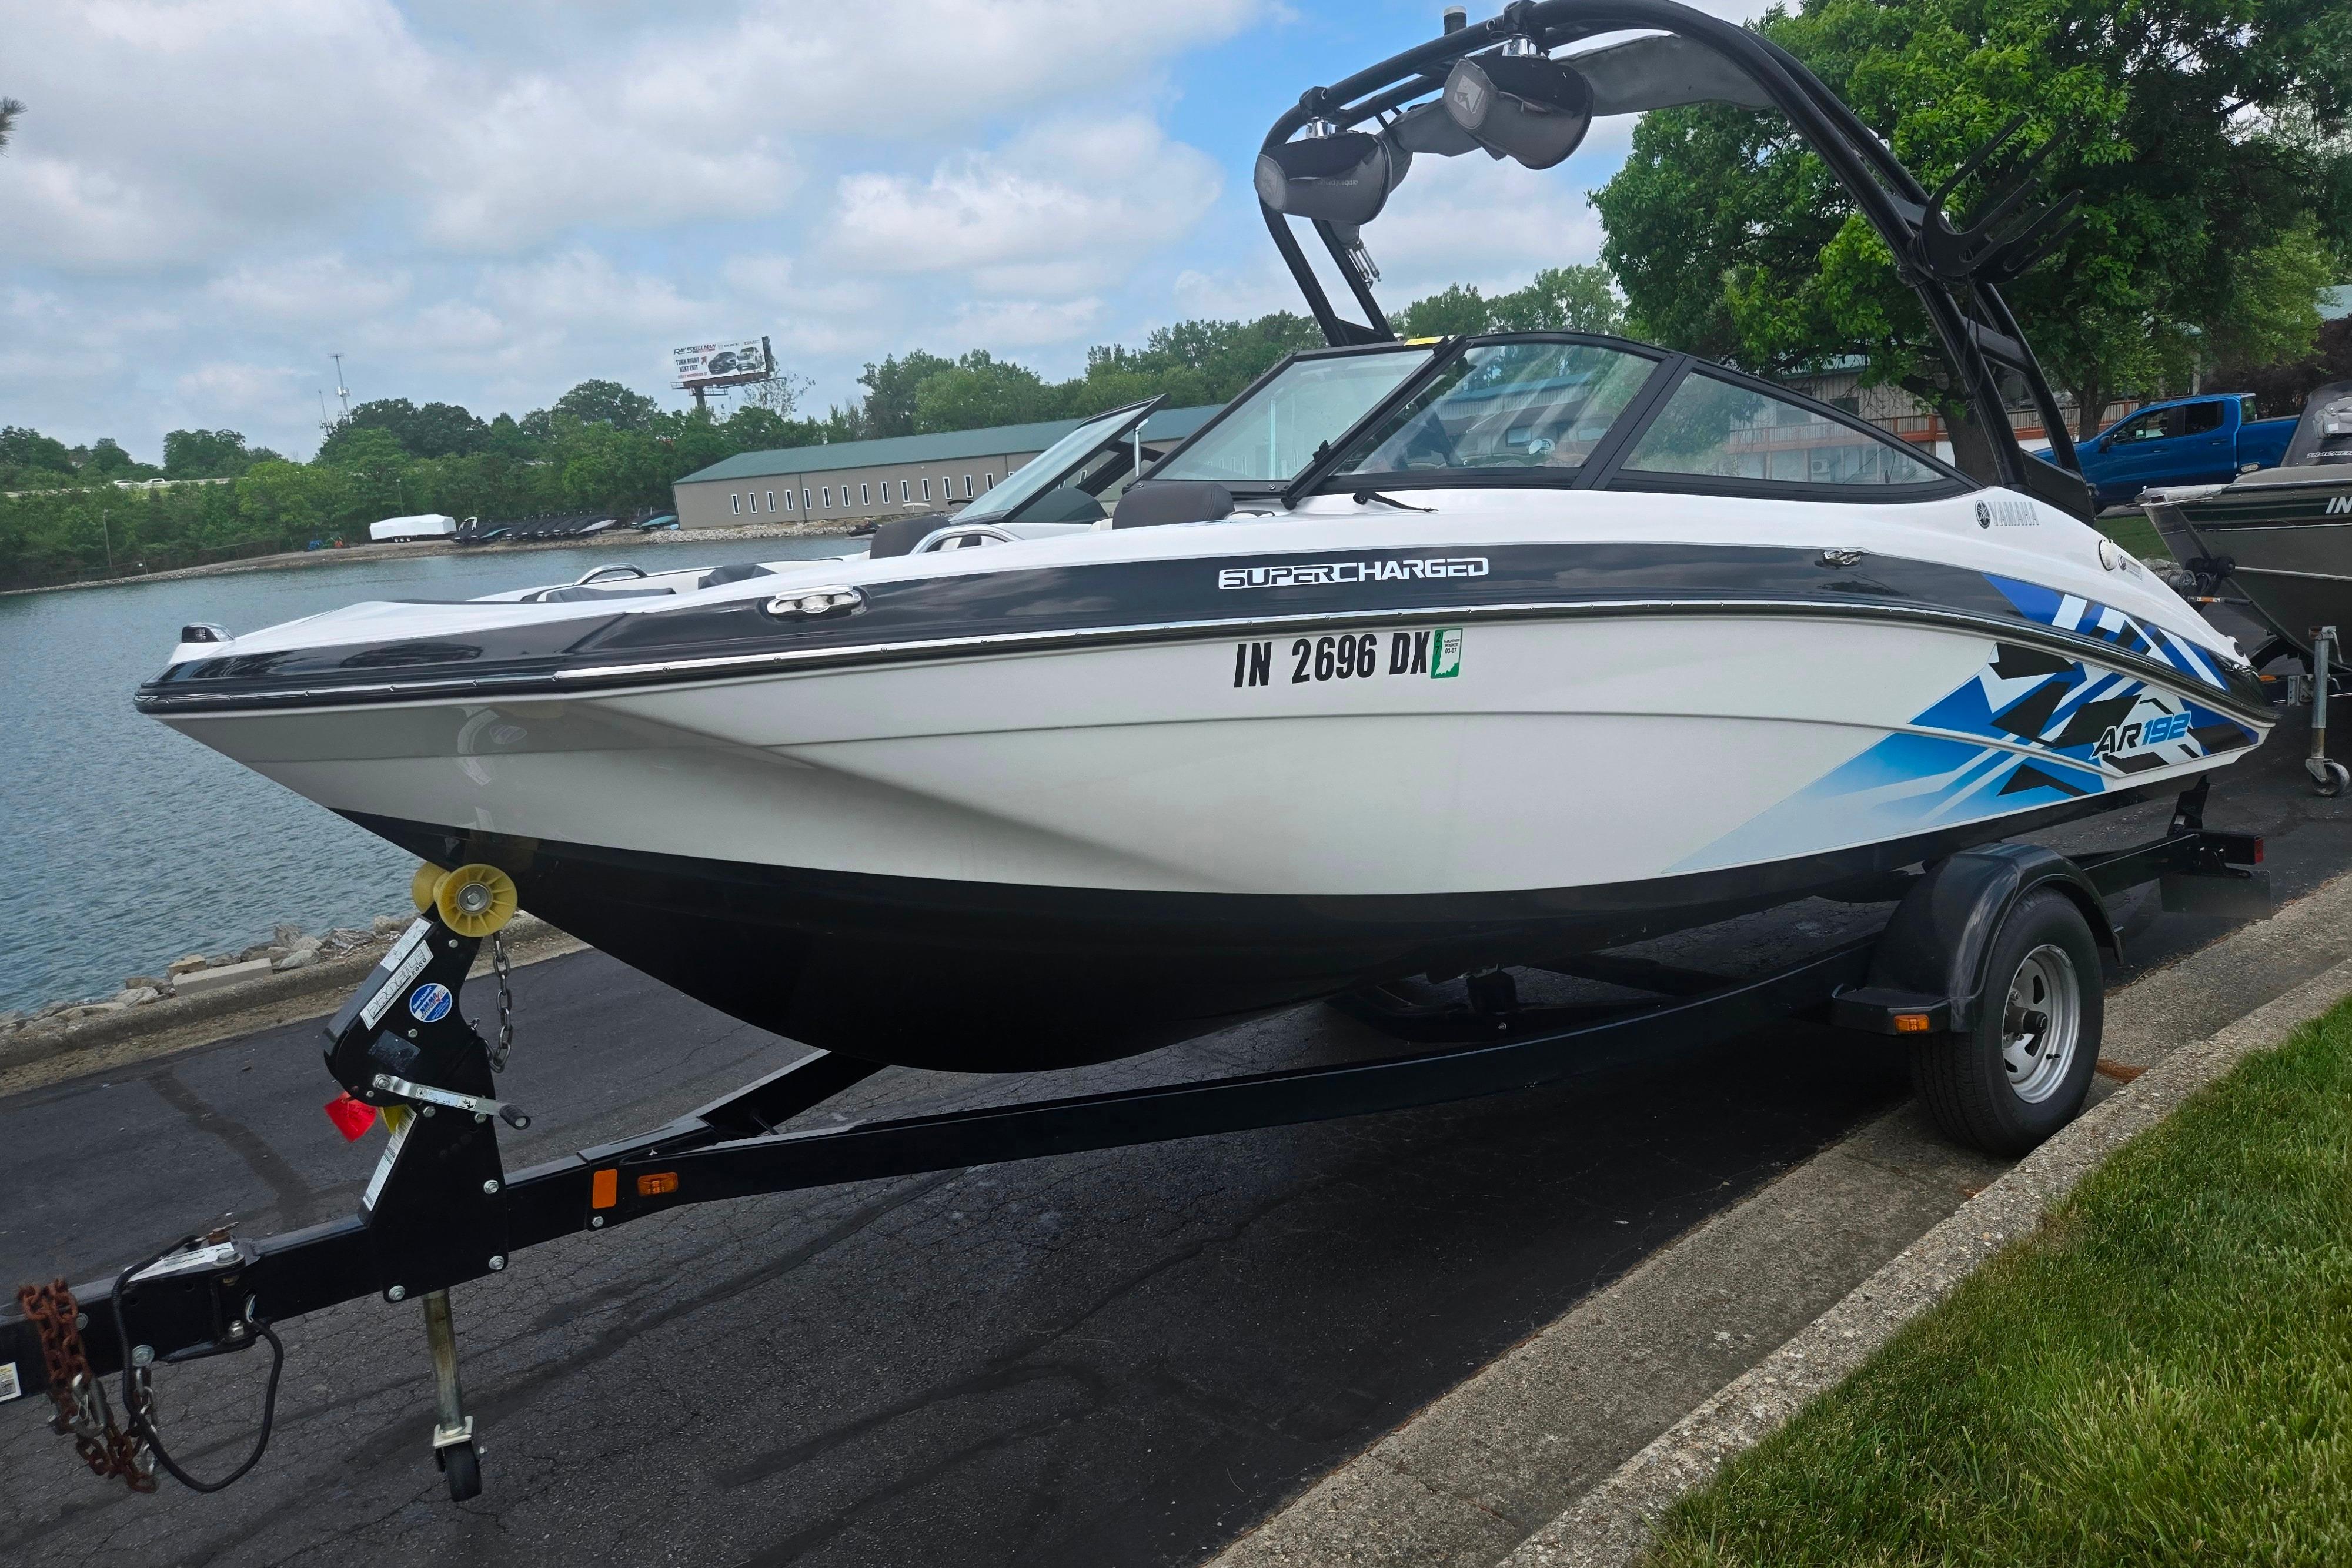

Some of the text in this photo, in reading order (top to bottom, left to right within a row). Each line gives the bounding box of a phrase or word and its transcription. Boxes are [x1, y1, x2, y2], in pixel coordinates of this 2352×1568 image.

[687, 344, 716, 353] SKILLMAN
[1987, 501, 2040, 526] YAMAHA
[1218, 557, 1489, 590] SUPERCHARGED
[1234, 631, 1430, 688] IN 2696 DX
[368, 948, 426, 1017] PROFILE
